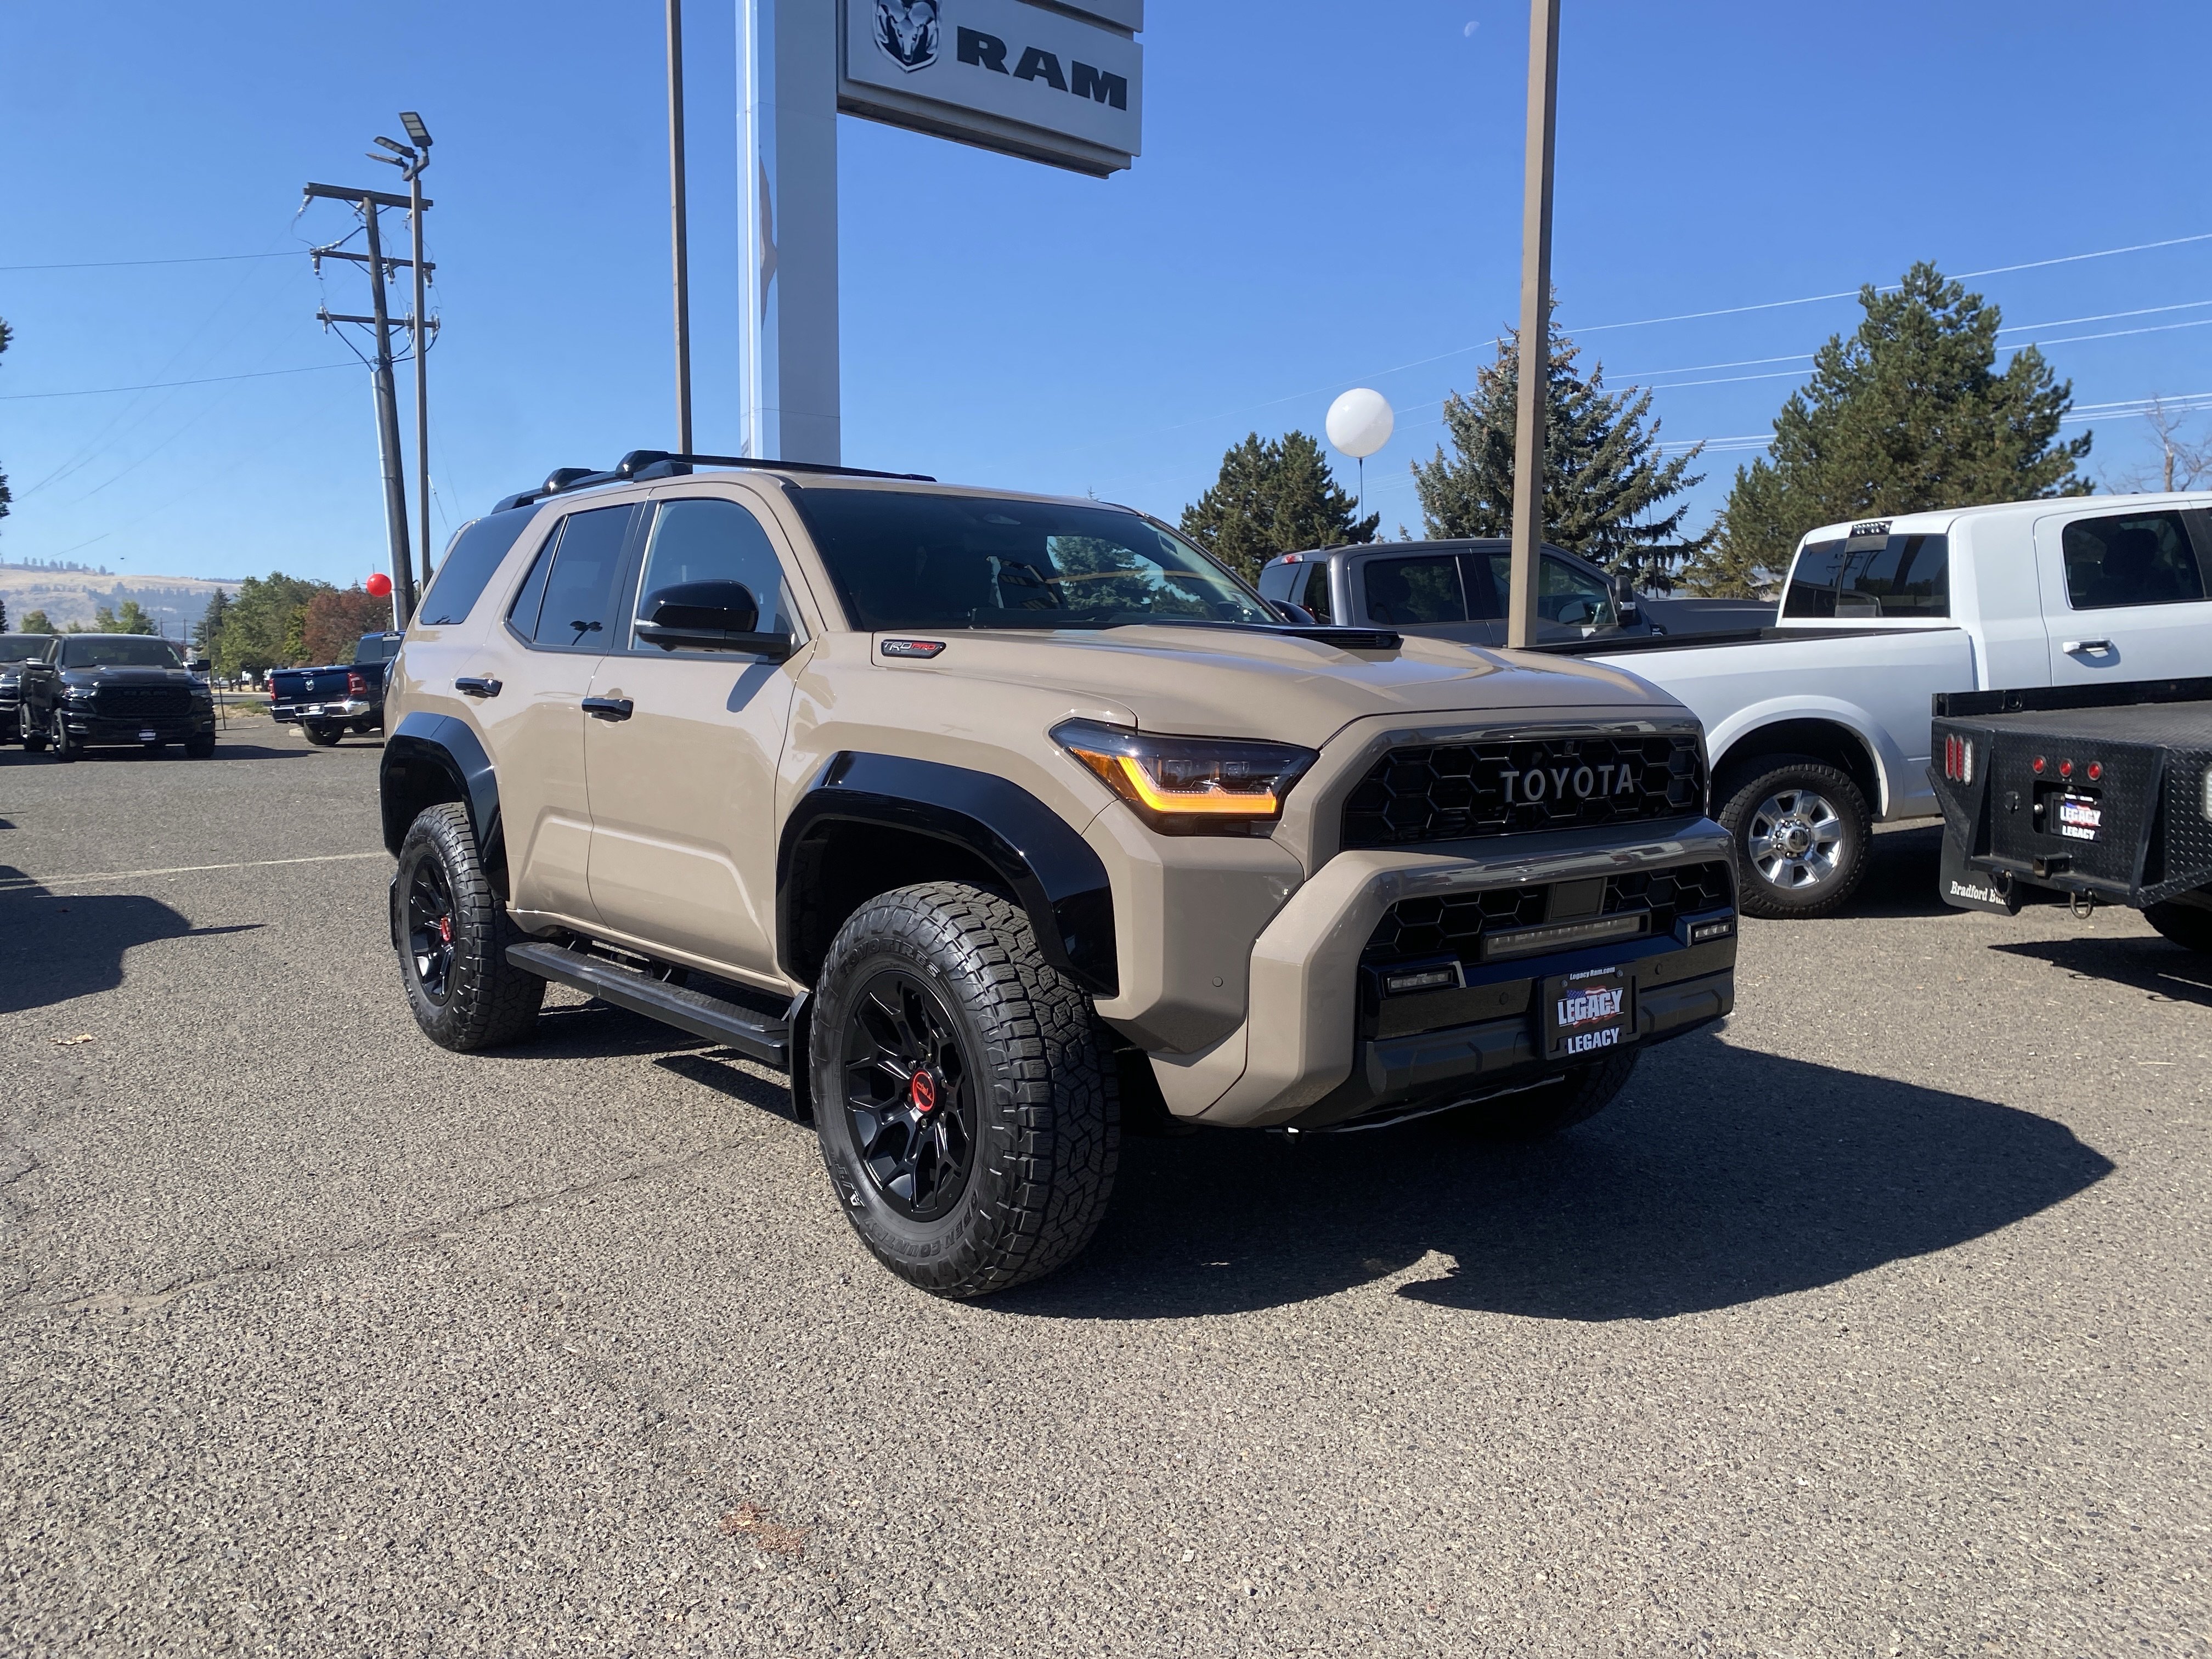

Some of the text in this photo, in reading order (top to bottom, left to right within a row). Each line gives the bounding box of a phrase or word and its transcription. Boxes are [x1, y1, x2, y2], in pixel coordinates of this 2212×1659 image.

[957, 25, 1127, 111] RAM
[884, 641, 912, 652] TRD
[1499, 764, 1634, 803] TOYOTA
[2060, 806, 2101, 825] LEGACY
[2062, 825, 2096, 840] LEGACY
[1950, 881, 1988, 901] Bradford
[880, 938, 941, 978] TIRES
[1558, 989, 1623, 1025] LEGACY
[1567, 1028, 1620, 1054] LEGACY
[863, 1217, 941, 1257] COUNTRY
[942, 1188, 979, 1250] OPEN
